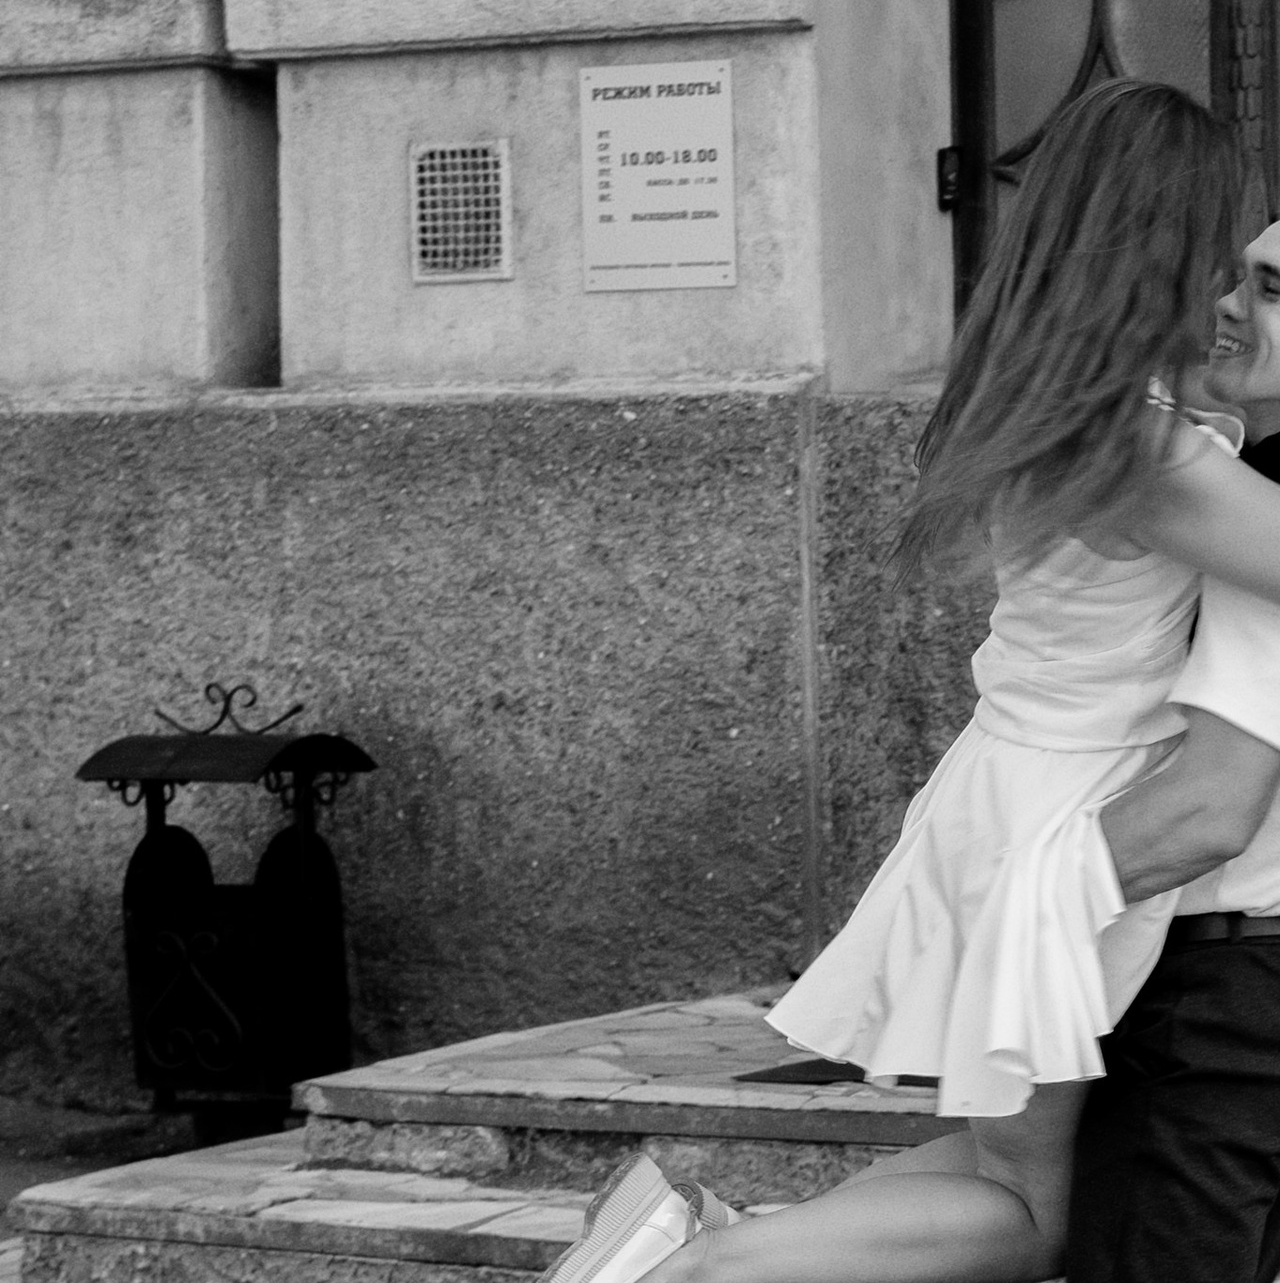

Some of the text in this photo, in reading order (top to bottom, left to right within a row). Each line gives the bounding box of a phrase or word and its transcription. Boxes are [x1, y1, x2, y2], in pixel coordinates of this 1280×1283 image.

[591, 81, 722, 102] РЕЖИМ РАБОТЫ
[620, 147, 718, 167] 10.00-18.00
